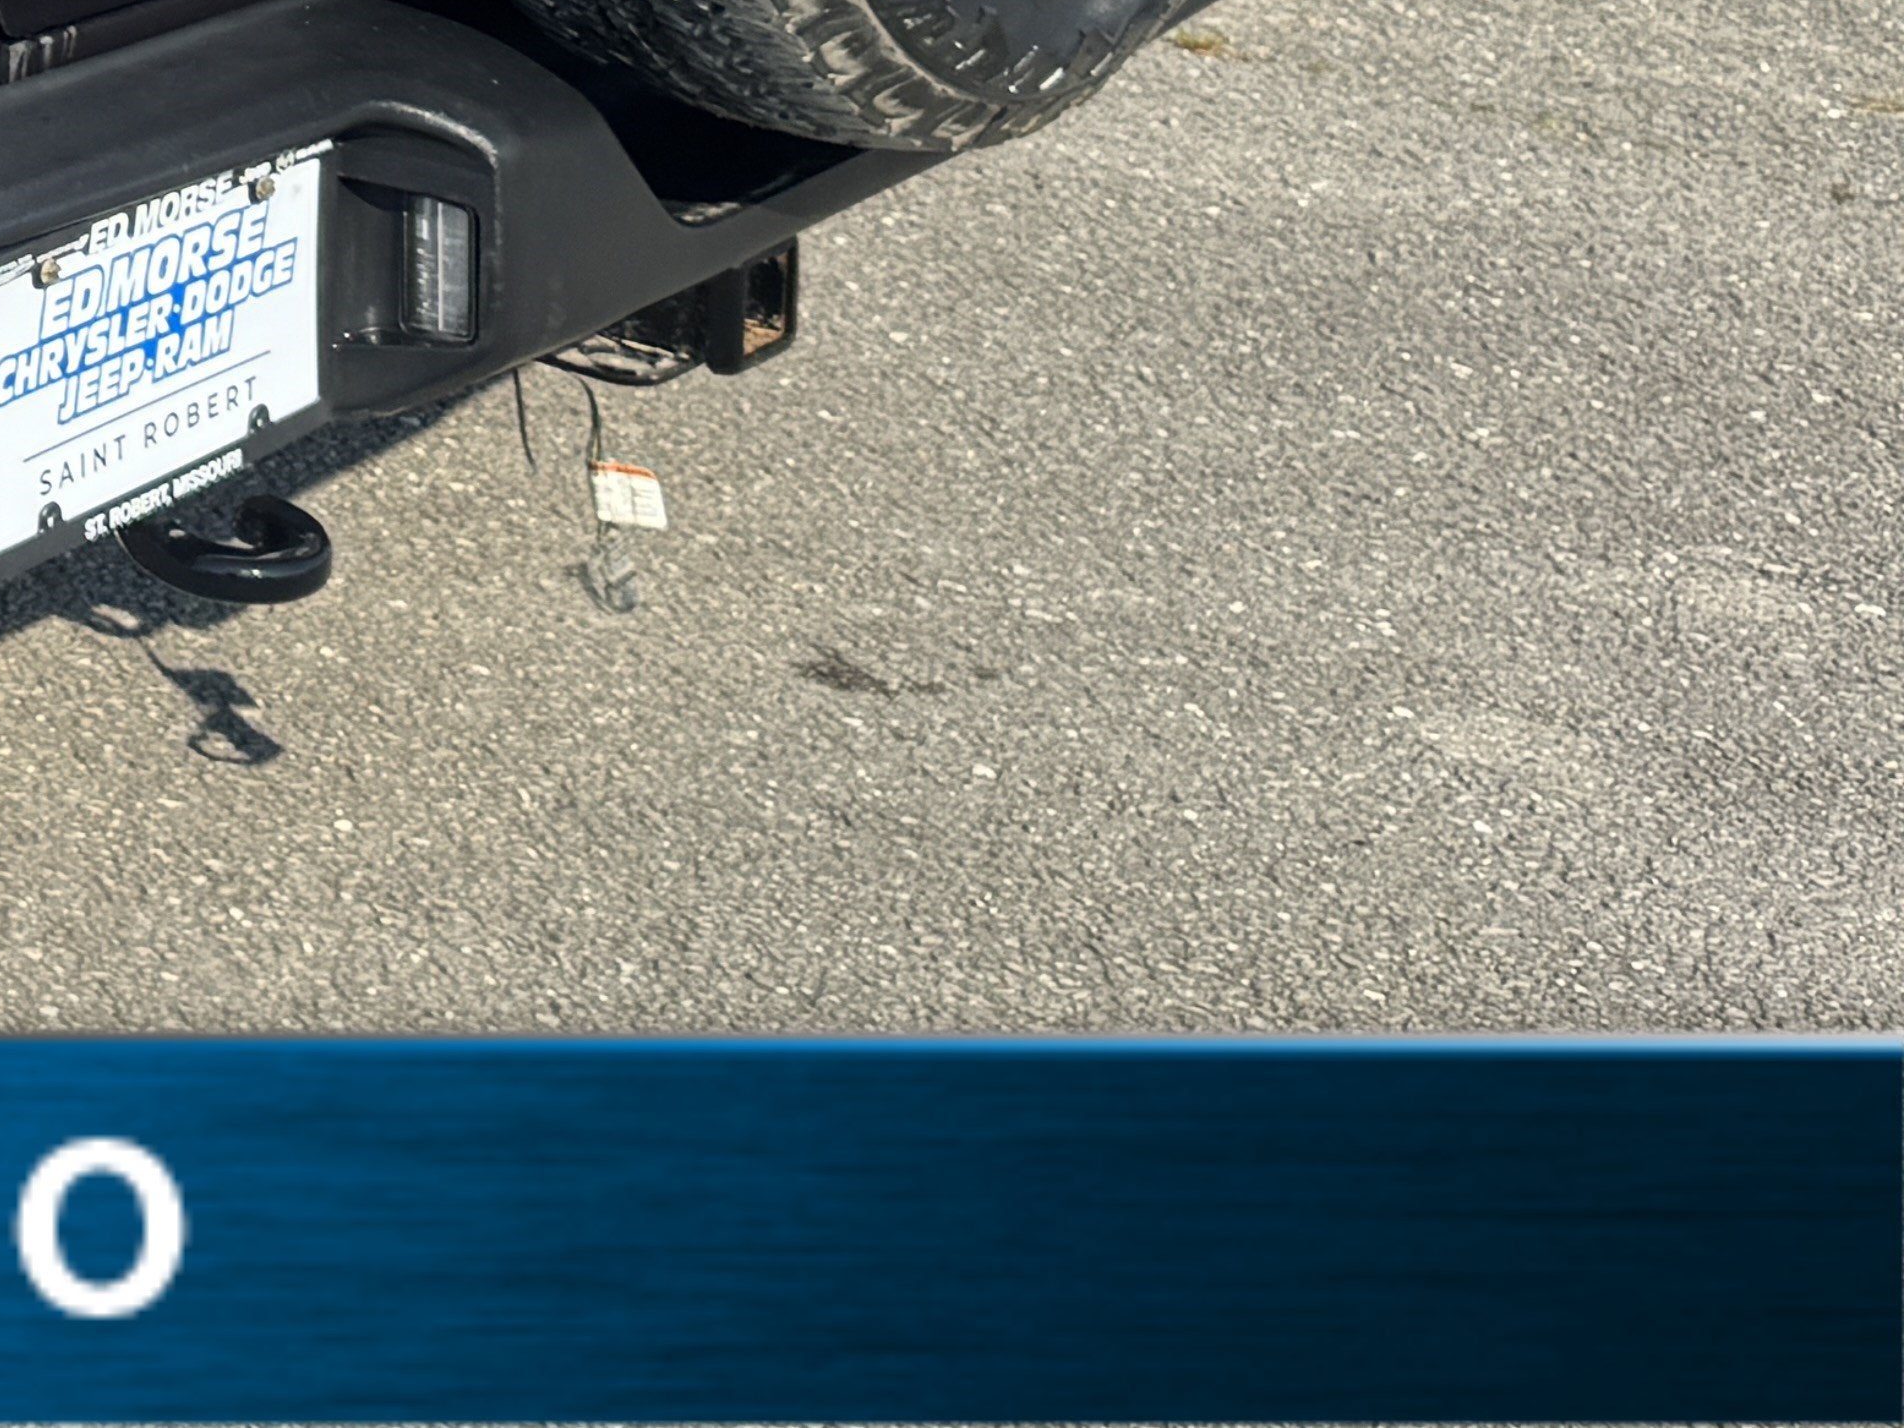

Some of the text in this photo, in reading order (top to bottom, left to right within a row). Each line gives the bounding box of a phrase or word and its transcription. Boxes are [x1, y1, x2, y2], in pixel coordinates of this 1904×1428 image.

[41, 199, 270, 340] ED MORSE
[88, 211, 131, 254] ED
[132, 169, 234, 241] MORSE
[39, 375, 258, 496] SAINT ROBERT
